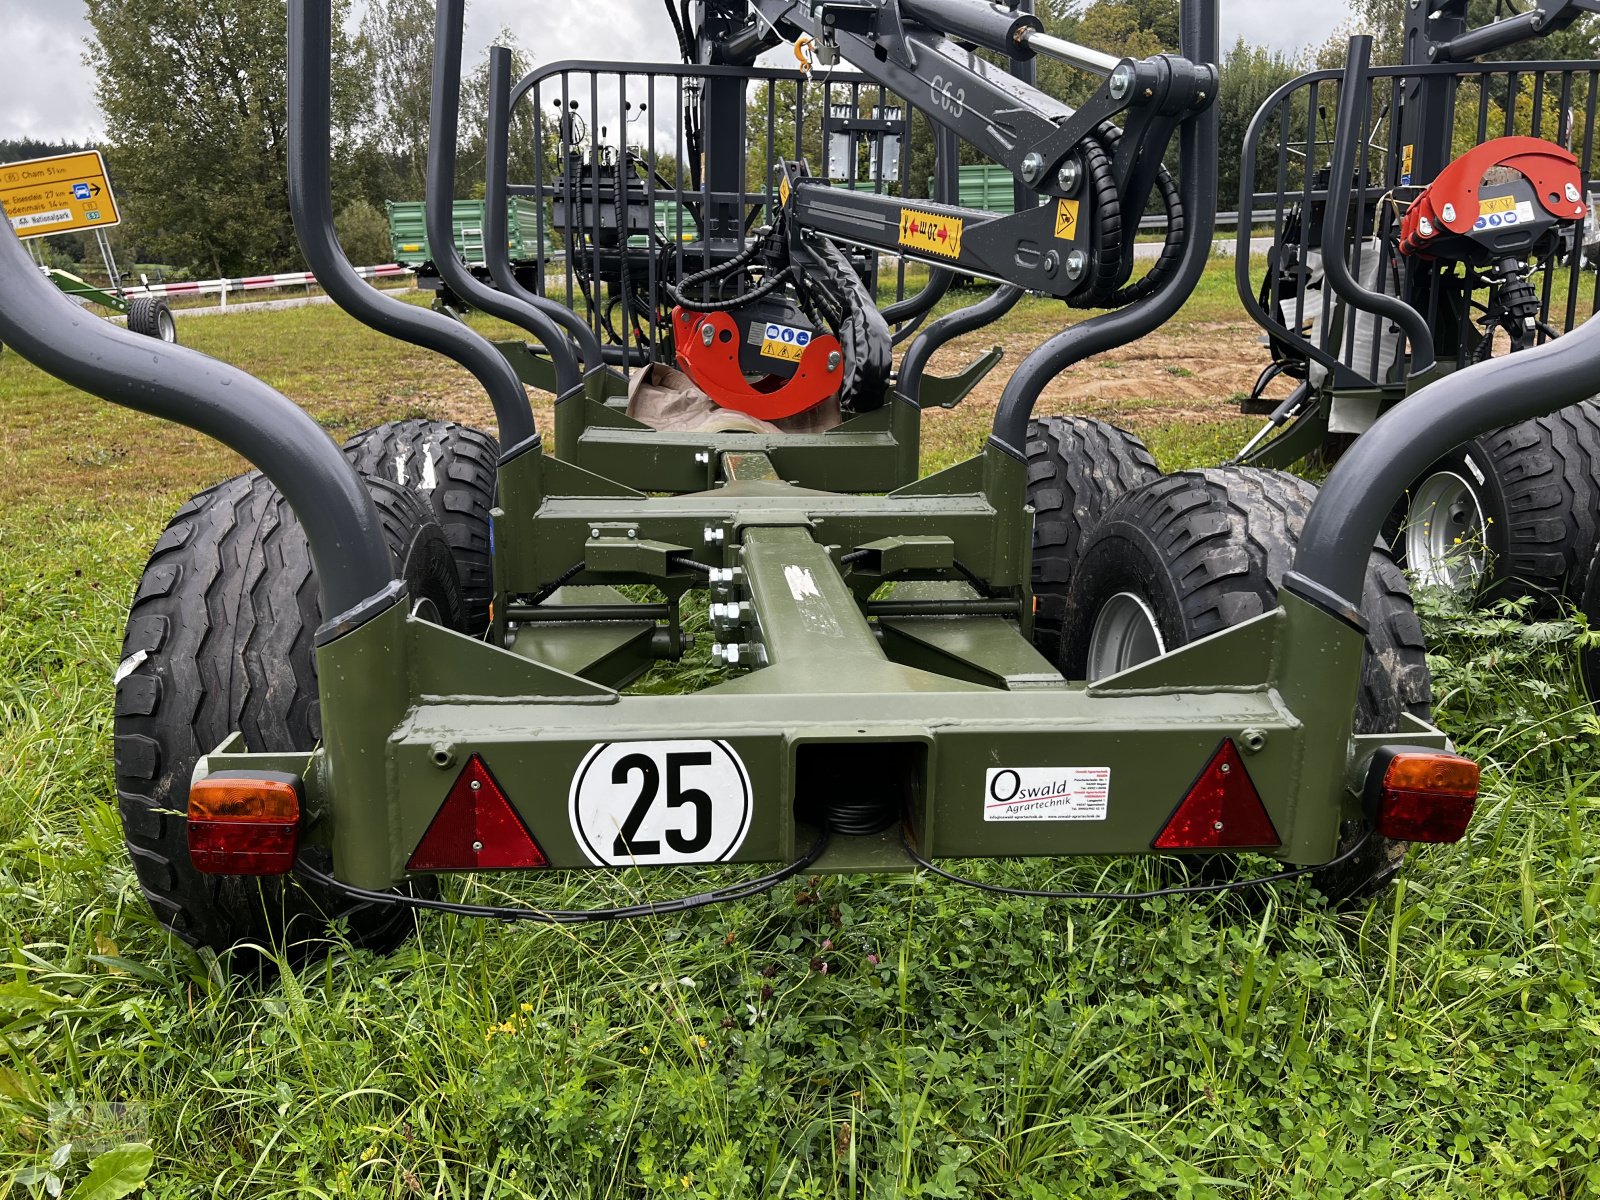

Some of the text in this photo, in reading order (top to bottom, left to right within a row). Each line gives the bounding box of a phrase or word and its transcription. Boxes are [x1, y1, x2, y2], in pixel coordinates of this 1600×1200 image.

[931, 75, 965, 118] C6.3
[22, 170, 45, 179] Cham
[47, 166, 56, 175] 51
[45, 190, 54, 199] 27
[31, 211, 70, 223] Nationalpark
[920, 221, 938, 241] 20 m
[990, 769, 1068, 802] Oswald
[612, 752, 712, 856] 25
[1006, 797, 1071, 814] Agrartechnik
